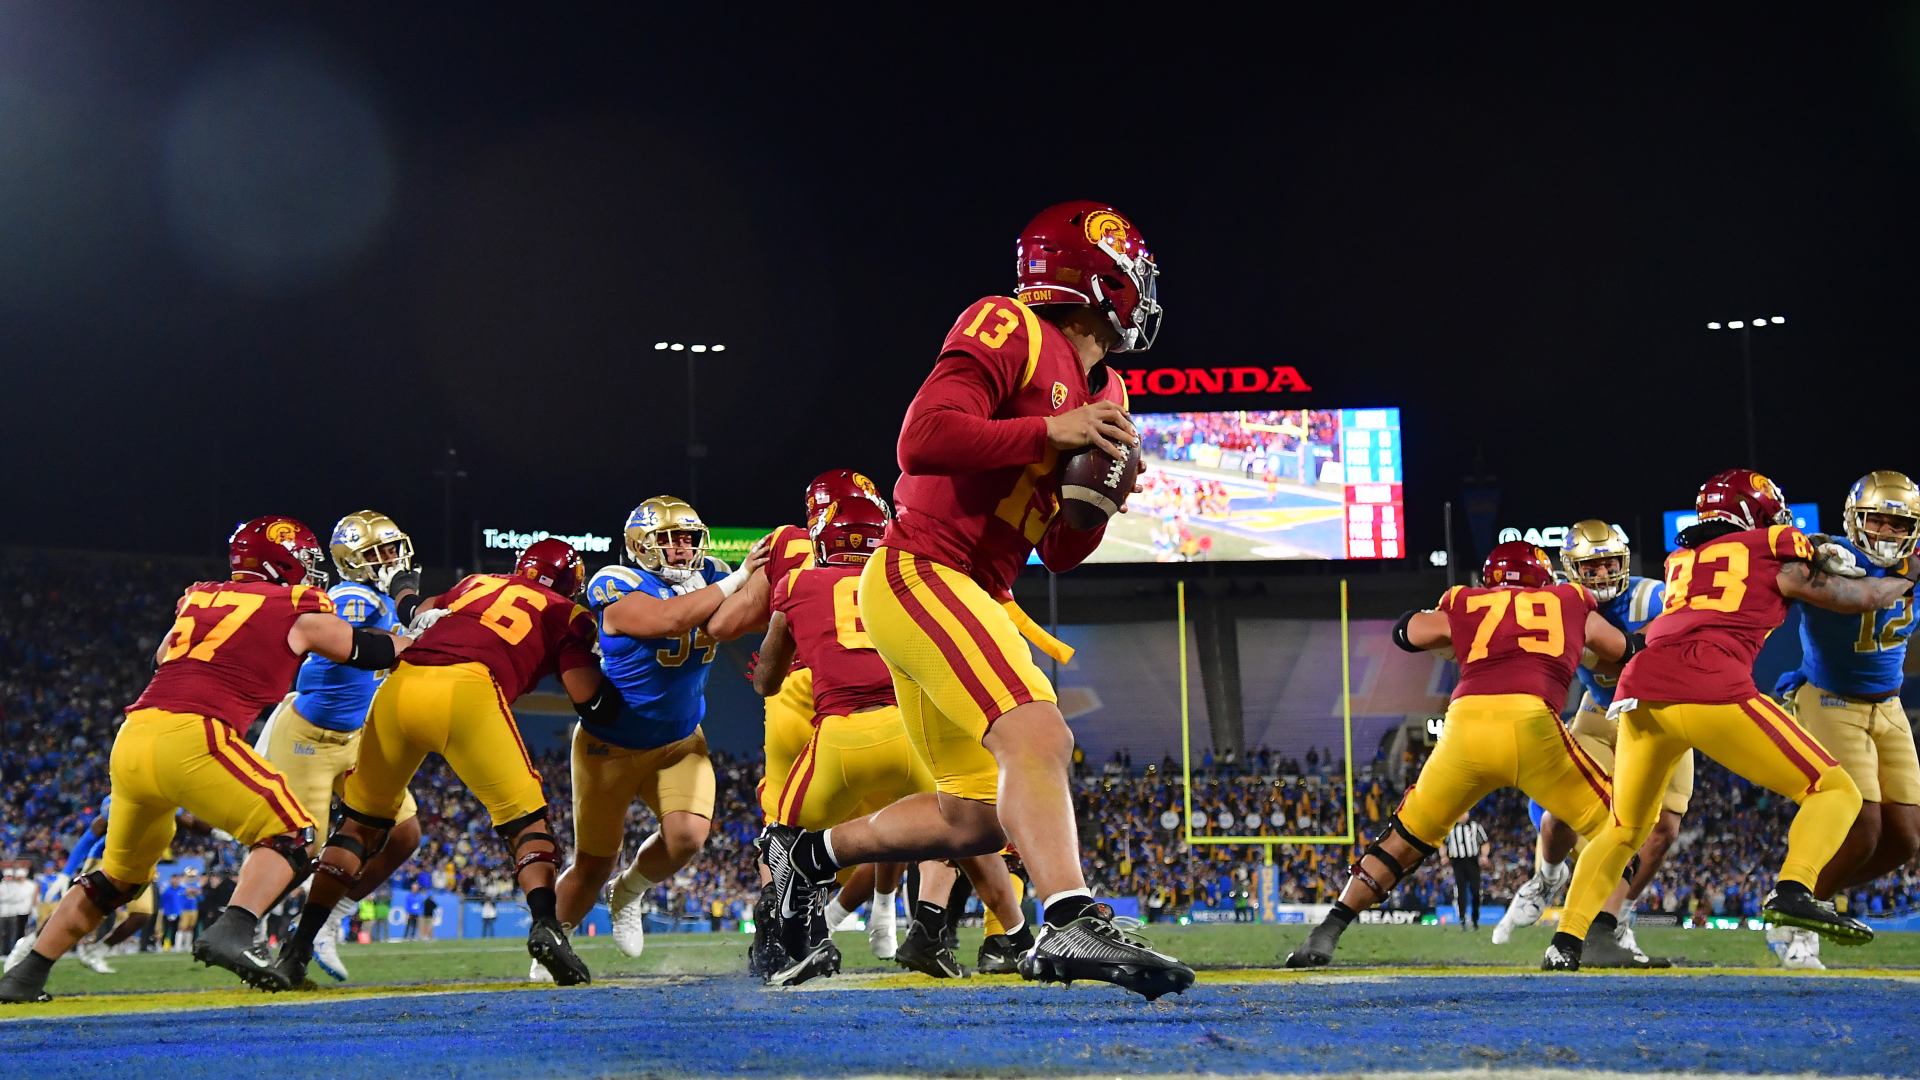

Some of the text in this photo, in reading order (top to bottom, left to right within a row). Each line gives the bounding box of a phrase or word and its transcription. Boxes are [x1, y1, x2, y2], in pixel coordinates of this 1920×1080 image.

[1033, 290, 1052, 301] ON!
[963, 302, 1019, 349] 13
[1117, 365, 1313, 395] HONDA
[483, 529, 612, 552] TicketSarter
[1523, 524, 1630, 548] ACA
[592, 578, 624, 605] 94
[1662, 541, 1750, 613] 83
[342, 598, 367, 622] 41
[448, 573, 548, 646] 76
[1854, 596, 1915, 653] 12
[1466, 590, 1565, 663] 79
